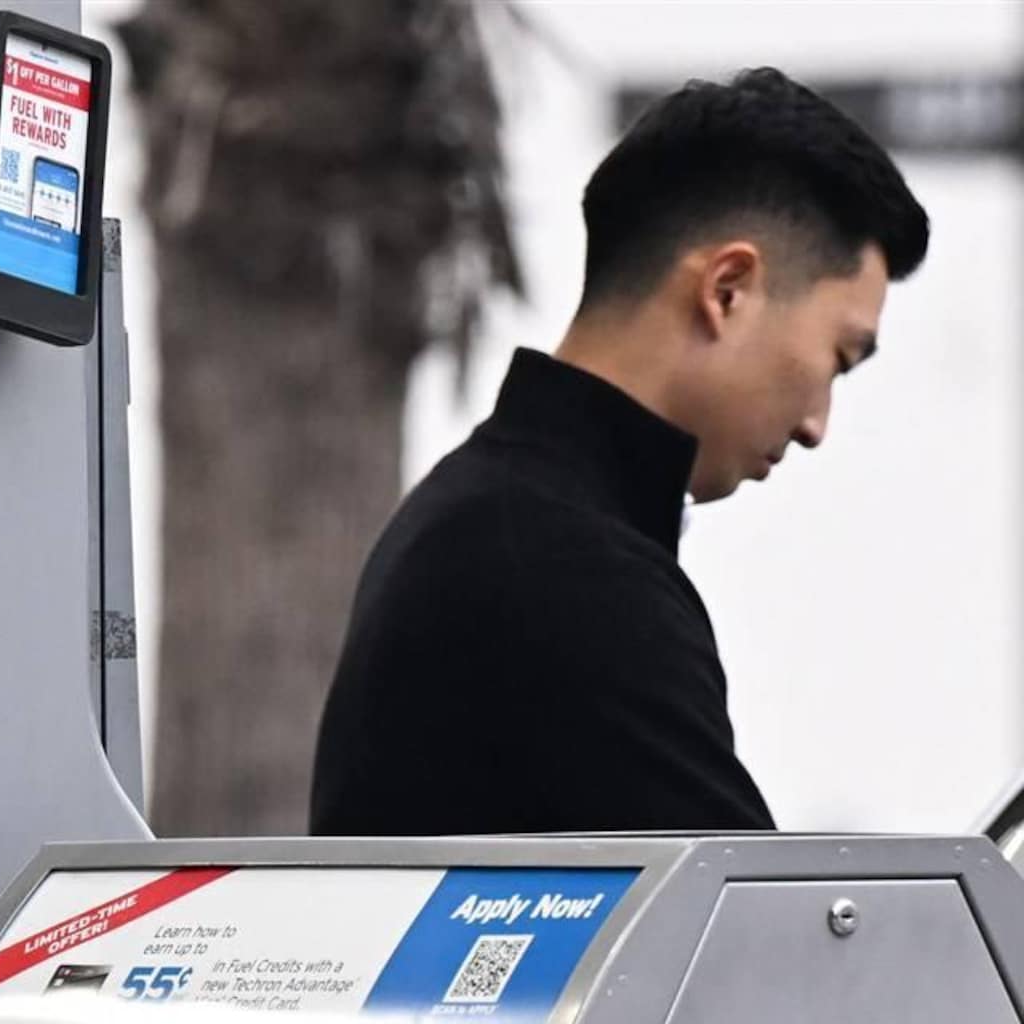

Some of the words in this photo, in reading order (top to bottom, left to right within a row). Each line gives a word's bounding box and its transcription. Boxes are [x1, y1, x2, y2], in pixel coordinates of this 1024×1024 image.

[10, 95, 38, 120] FUEL
[42, 106, 72, 131] WITH
[12, 117, 67, 150] REWARDS
[24, 894, 139, 955] LIMITED-TIME
[450, 894, 530, 925] Apply
[530, 893, 605, 919] Now!
[47, 919, 110, 955] OFFER!
[154, 926, 191, 939] Learn
[192, 925, 220, 938] how
[222, 925, 238, 938] to
[143, 944, 173, 955] earn
[175, 944, 193, 957] up
[193, 943, 209, 955] to
[212, 961, 227, 973] in
[226, 959, 255, 974] Fuel
[256, 959, 302, 974] Credits
[305, 959, 332, 974] with
[333, 961, 345, 974] a
[200, 980, 228, 992] new
[230, 978, 281, 993] Techron
